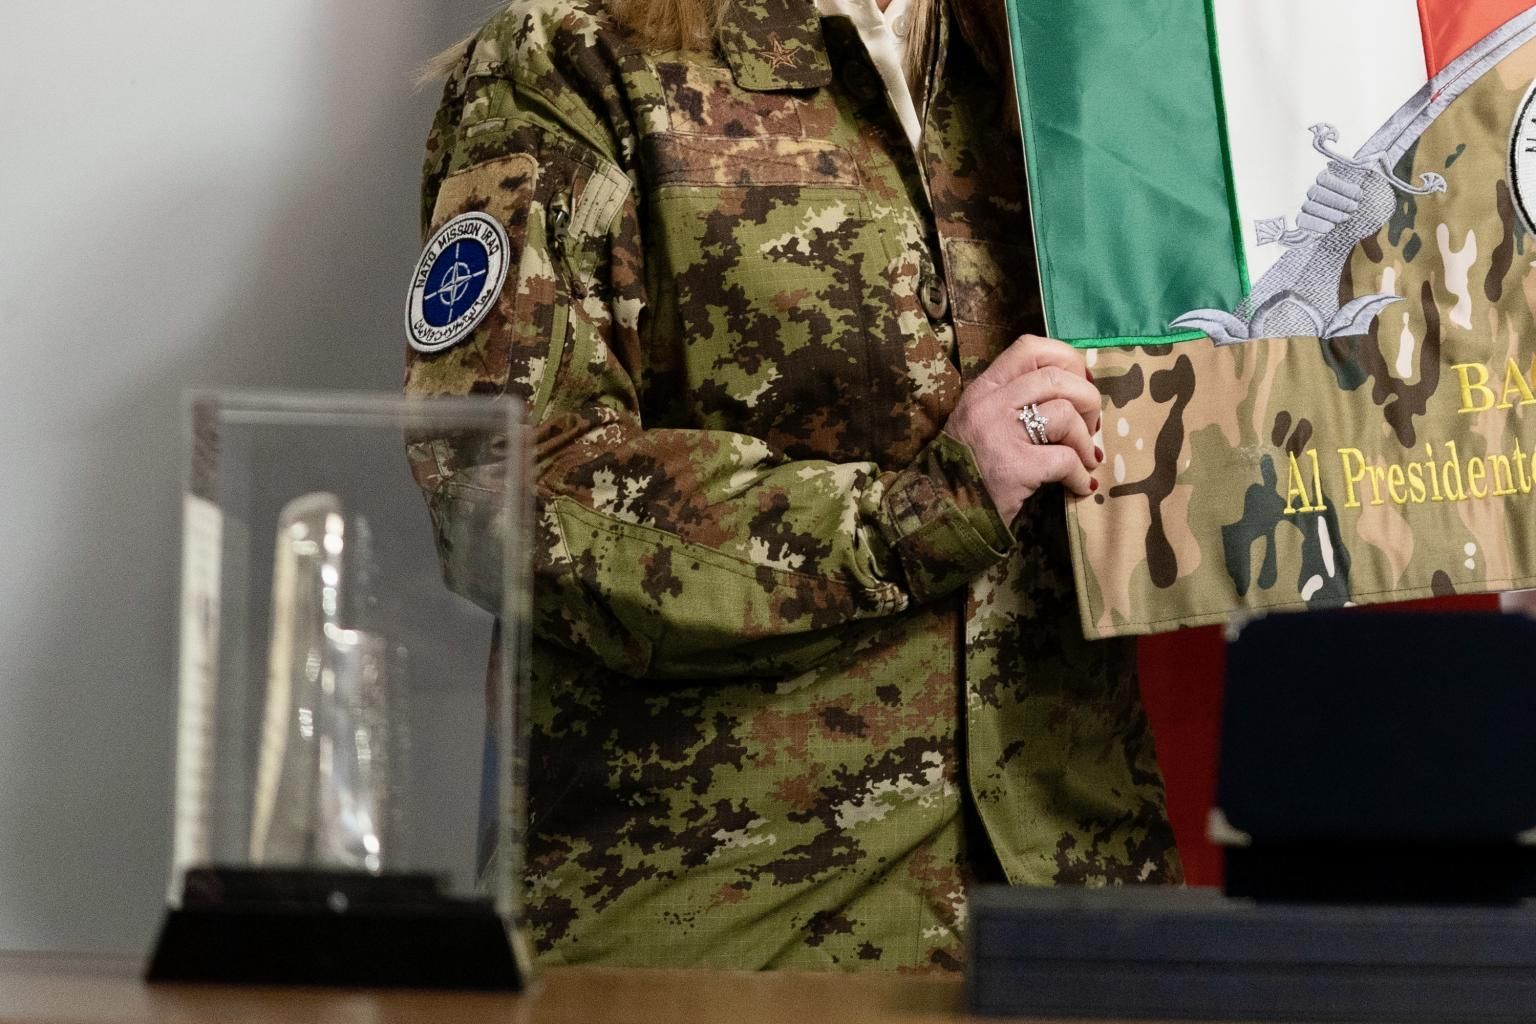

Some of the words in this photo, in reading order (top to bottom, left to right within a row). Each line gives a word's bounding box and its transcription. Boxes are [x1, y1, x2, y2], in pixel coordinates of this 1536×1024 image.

[415, 251, 437, 288] NATO
[438, 222, 482, 249] MISSION
[480, 227, 501, 257] IRAQ
[1283, 448, 1328, 515] Al
